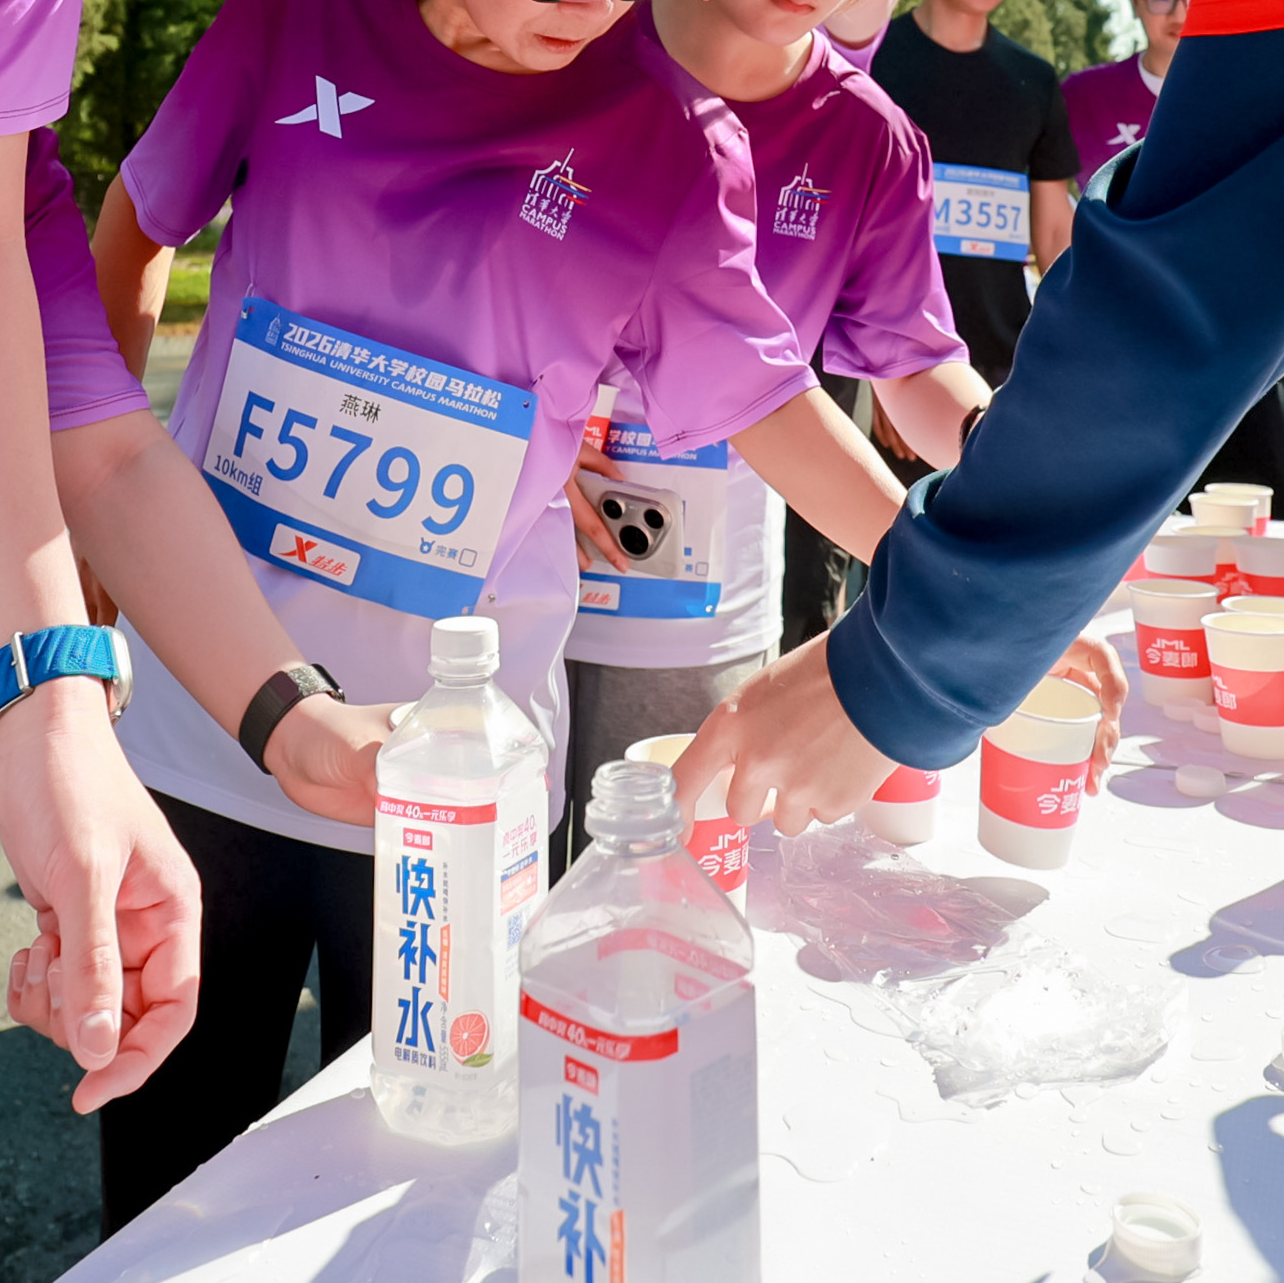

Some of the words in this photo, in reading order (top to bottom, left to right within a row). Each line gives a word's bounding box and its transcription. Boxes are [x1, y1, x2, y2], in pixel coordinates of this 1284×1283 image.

[519, 211, 564, 241] MARATHON
[522, 204, 567, 234] CAMPUS
[774, 221, 816, 235] CAMPUS
[934, 197, 1022, 232] M3557
[280, 341, 327, 365] TSINGHUA
[329, 359, 391, 387] UNIVERSITY
[391, 380, 437, 402] CAMPUS
[437, 395, 498, 421] MARATHON
[283, 322, 503, 410] 2026清华大学校园马拉松
[339, 393, 382, 424] 燕琳
[233, 390, 475, 536] F5799
[611, 445, 647, 457] CAMPUS
[214, 454, 264, 497] 10km组
[309, 554, 348, 577] 特步
[435, 545, 458, 561] 完赛
[1146, 648, 1198, 667] 今麦郎
[1151, 638, 1190, 651] JML
[404, 832, 431, 846] 今麦郎
[710, 827, 748, 851] JML
[396, 854, 437, 1053] 快补水
[394, 1047, 437, 1070] 电解质饮料
[556, 1093, 606, 1283] 快补
